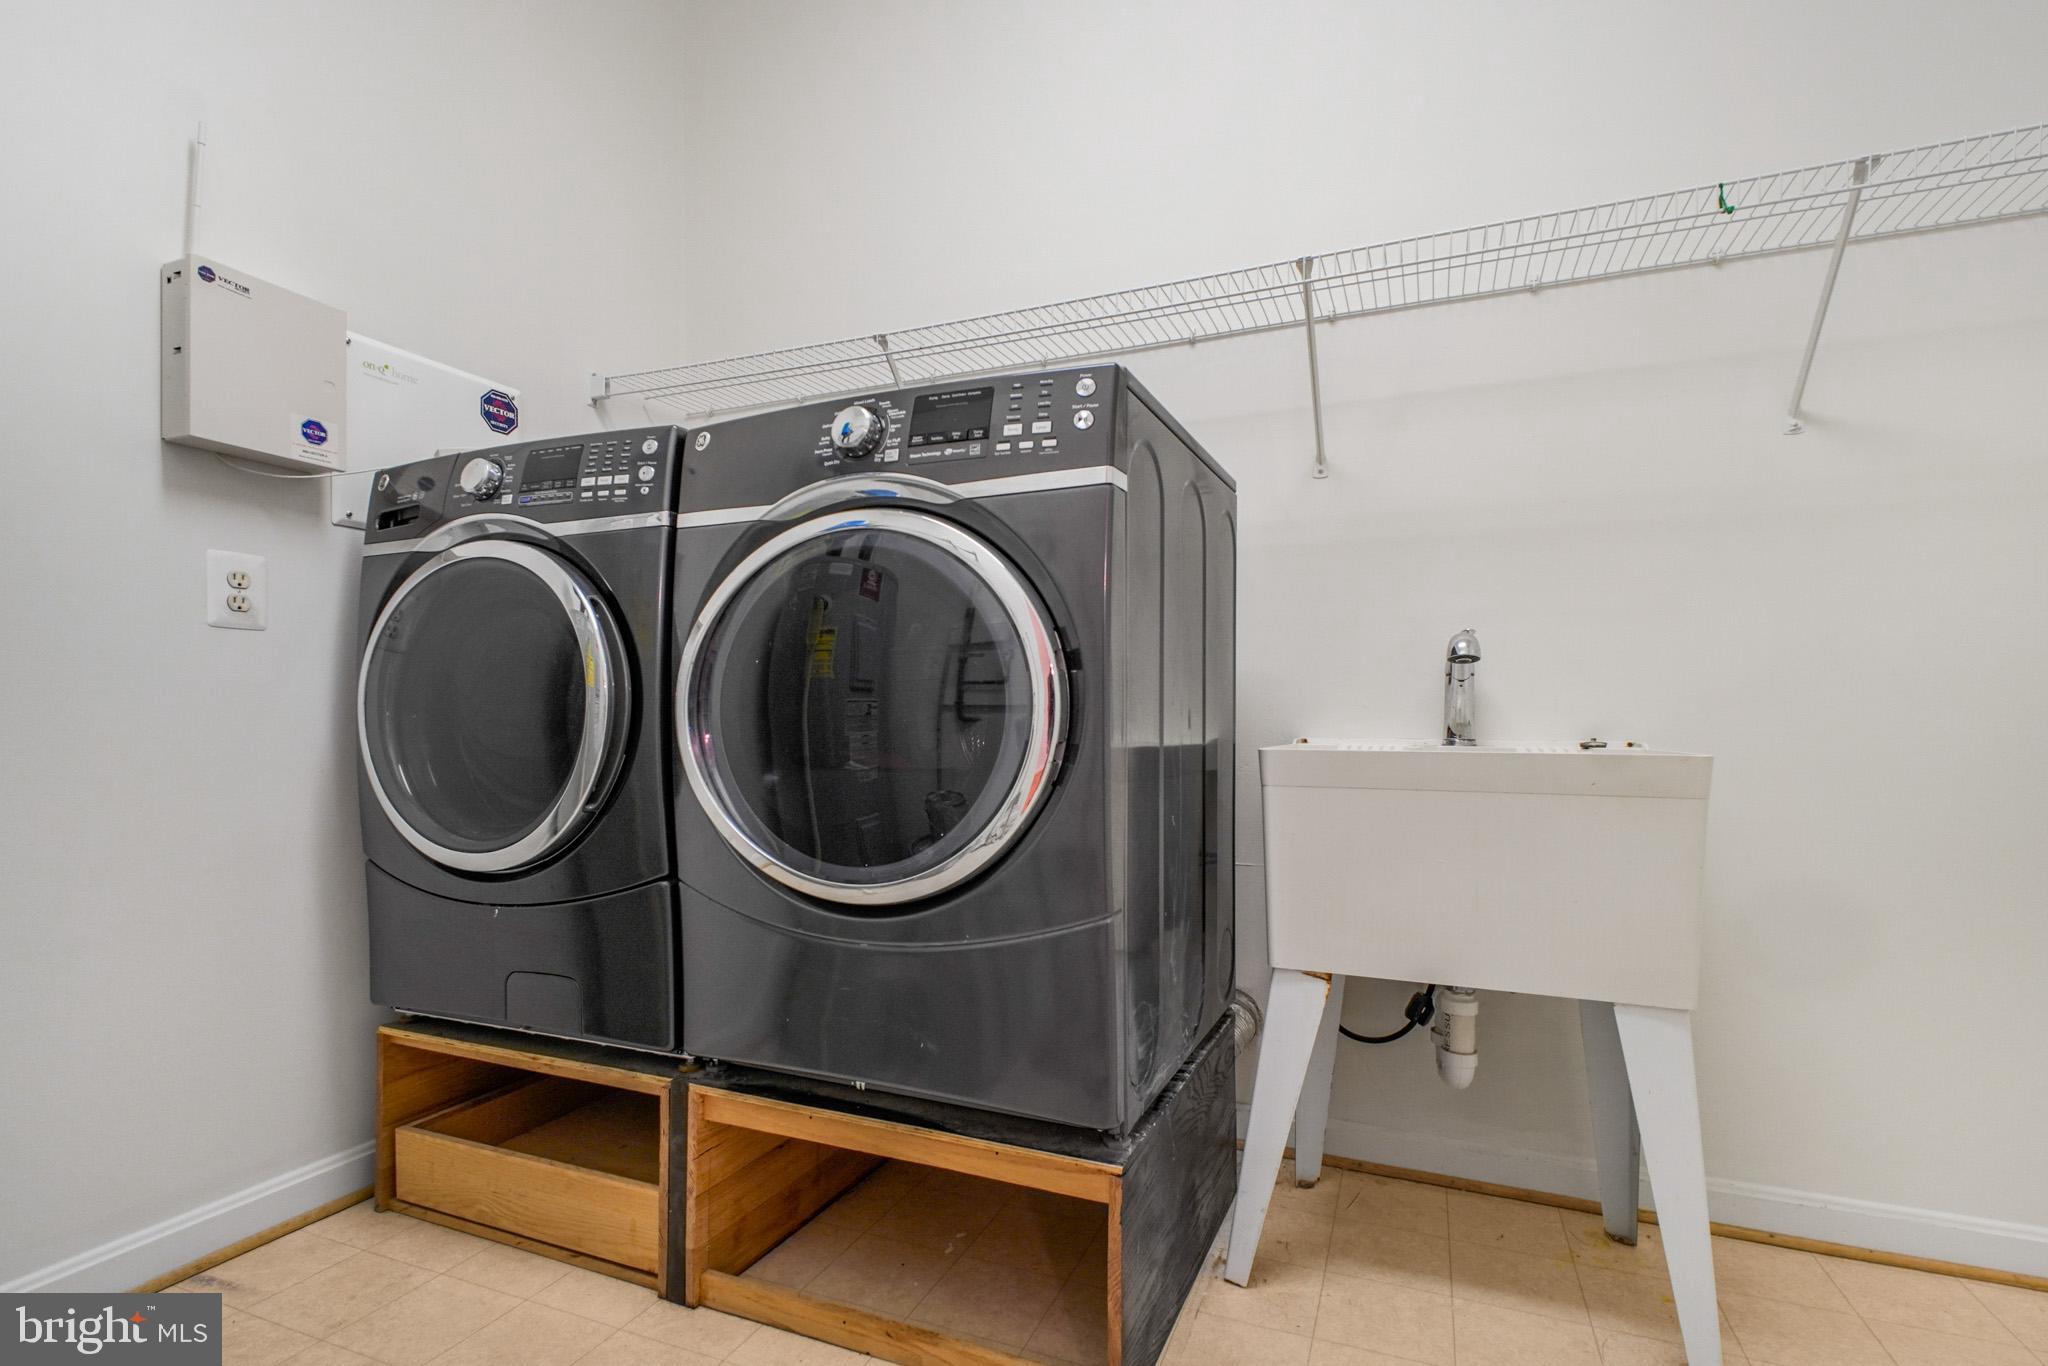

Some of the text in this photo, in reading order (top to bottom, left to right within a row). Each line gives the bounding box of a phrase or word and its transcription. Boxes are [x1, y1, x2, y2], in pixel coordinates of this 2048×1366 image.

[217, 275, 250, 293] VECTOR
[484, 403, 515, 419] VECTOR
[302, 427, 328, 438] VECTOR
